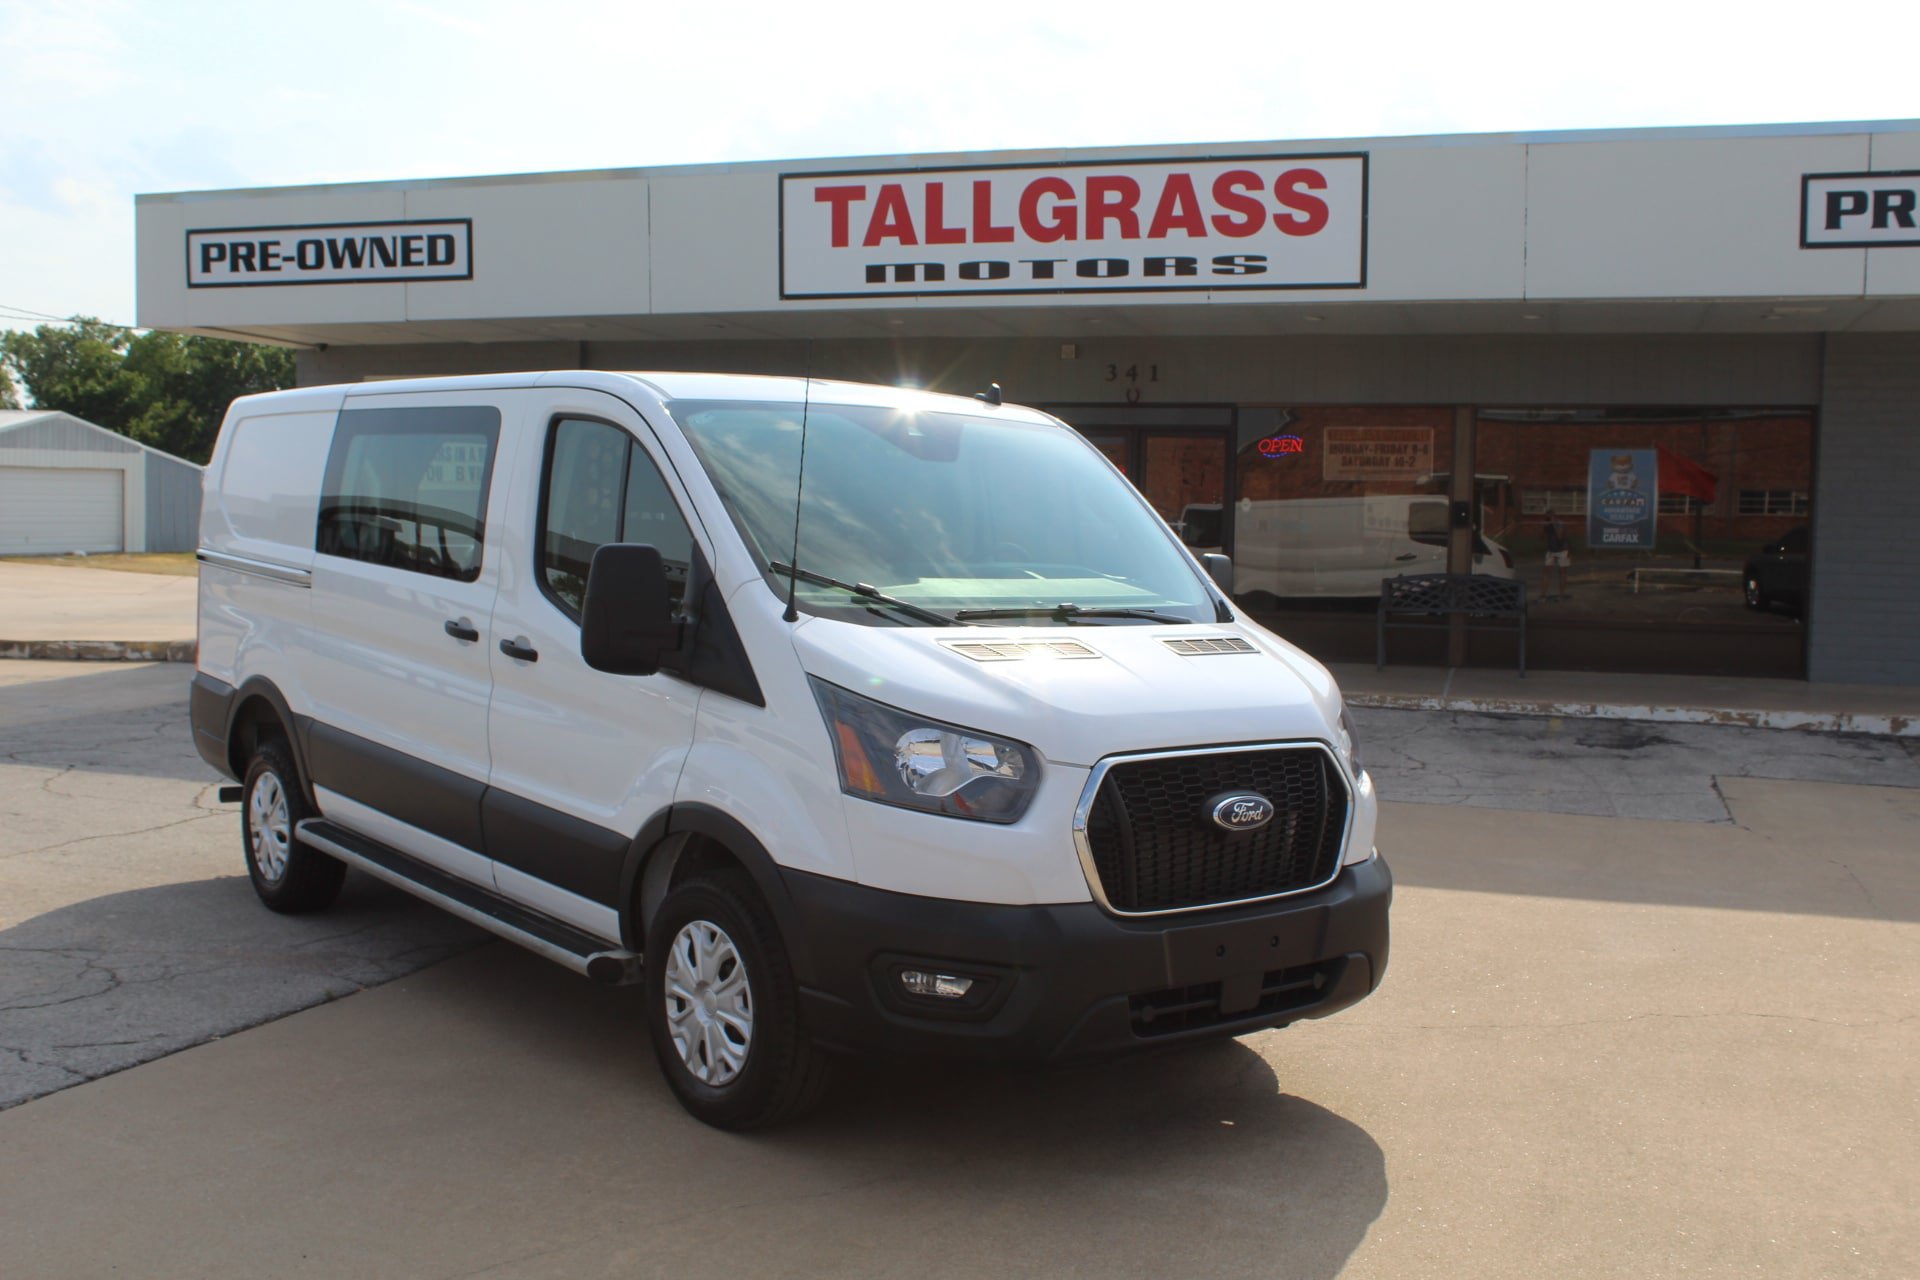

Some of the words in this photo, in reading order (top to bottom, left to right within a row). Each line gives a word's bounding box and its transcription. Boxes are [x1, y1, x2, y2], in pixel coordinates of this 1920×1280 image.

[814, 168, 1330, 248] TALLGRASS
[200, 234, 455, 273] PRE-OWNED
[865, 254, 1268, 284] MOTORS
[1257, 438, 1304, 453] OPEN
[1342, 455, 1391, 467] SATURDAY
[1603, 533, 1639, 543] CARFAX
[1231, 802, 1264, 823] Ford
